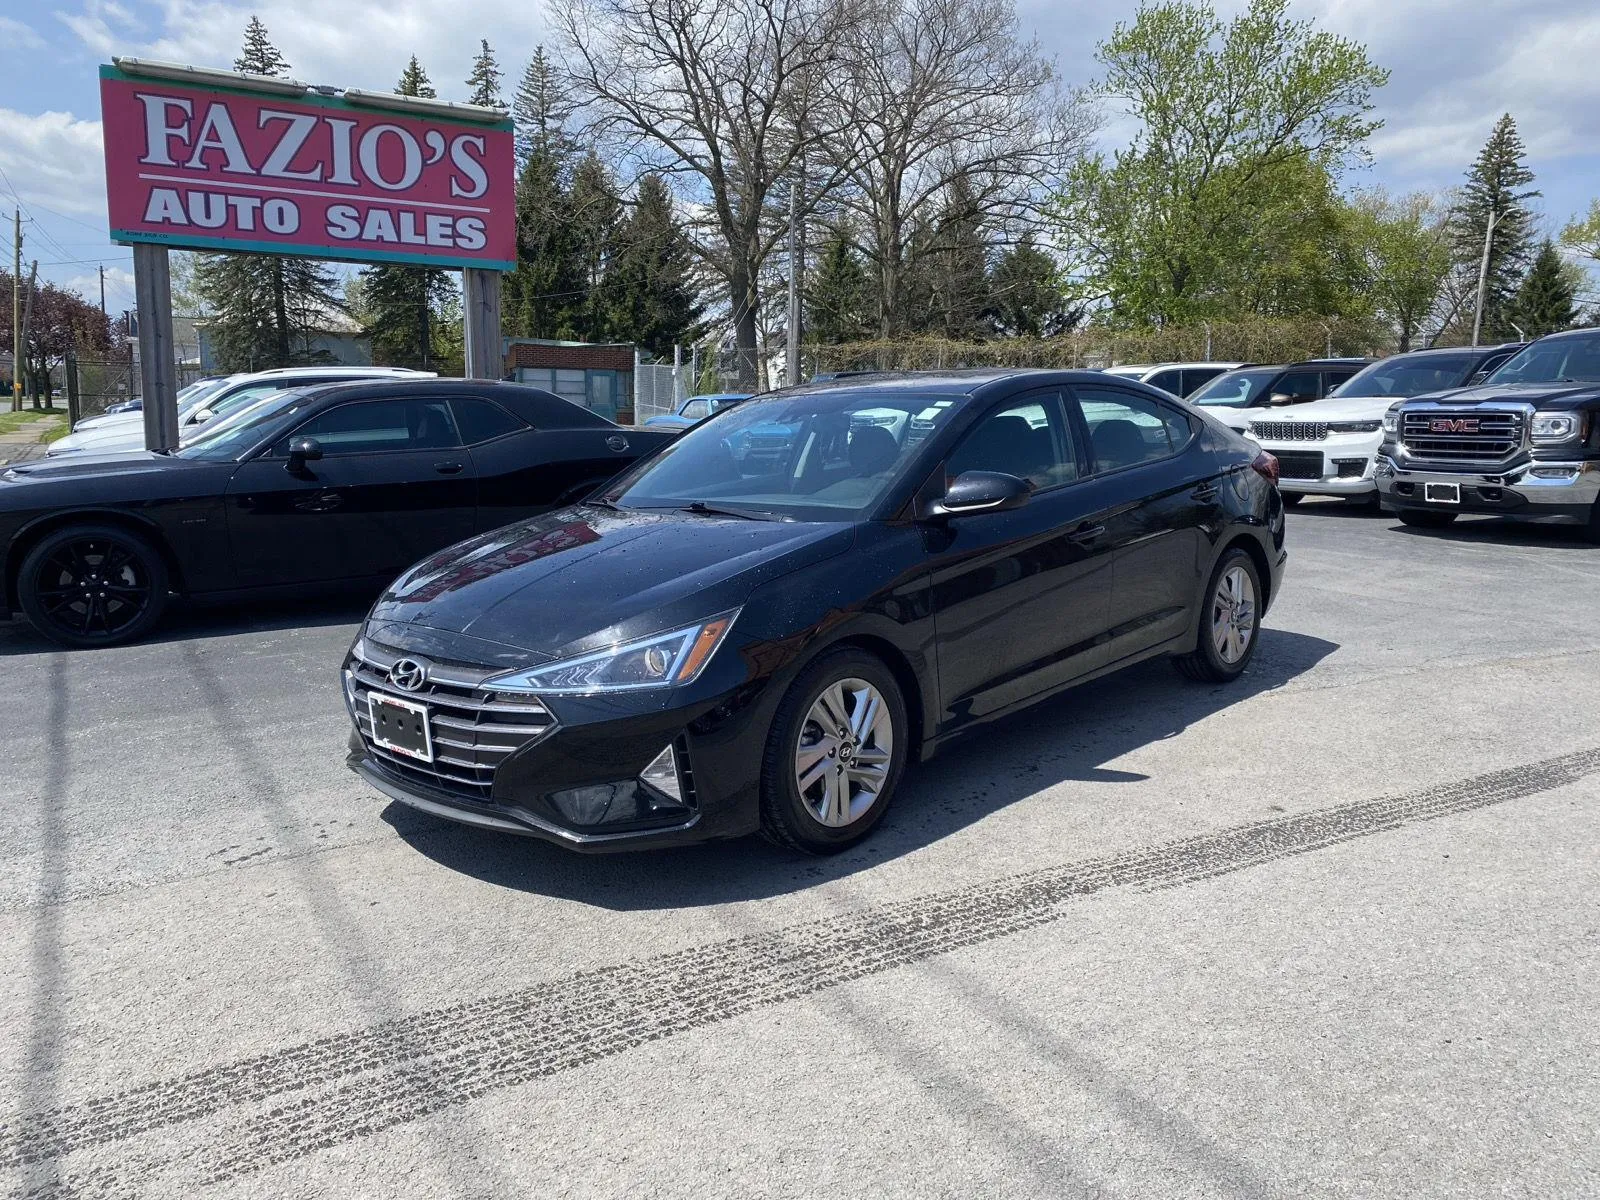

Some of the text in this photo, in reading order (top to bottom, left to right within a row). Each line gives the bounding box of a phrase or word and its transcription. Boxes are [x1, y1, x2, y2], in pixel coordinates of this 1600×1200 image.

[134, 92, 490, 198] FAZIO’S
[144, 187, 488, 250] AUTO SALES
[1431, 419, 1479, 432] GMC
